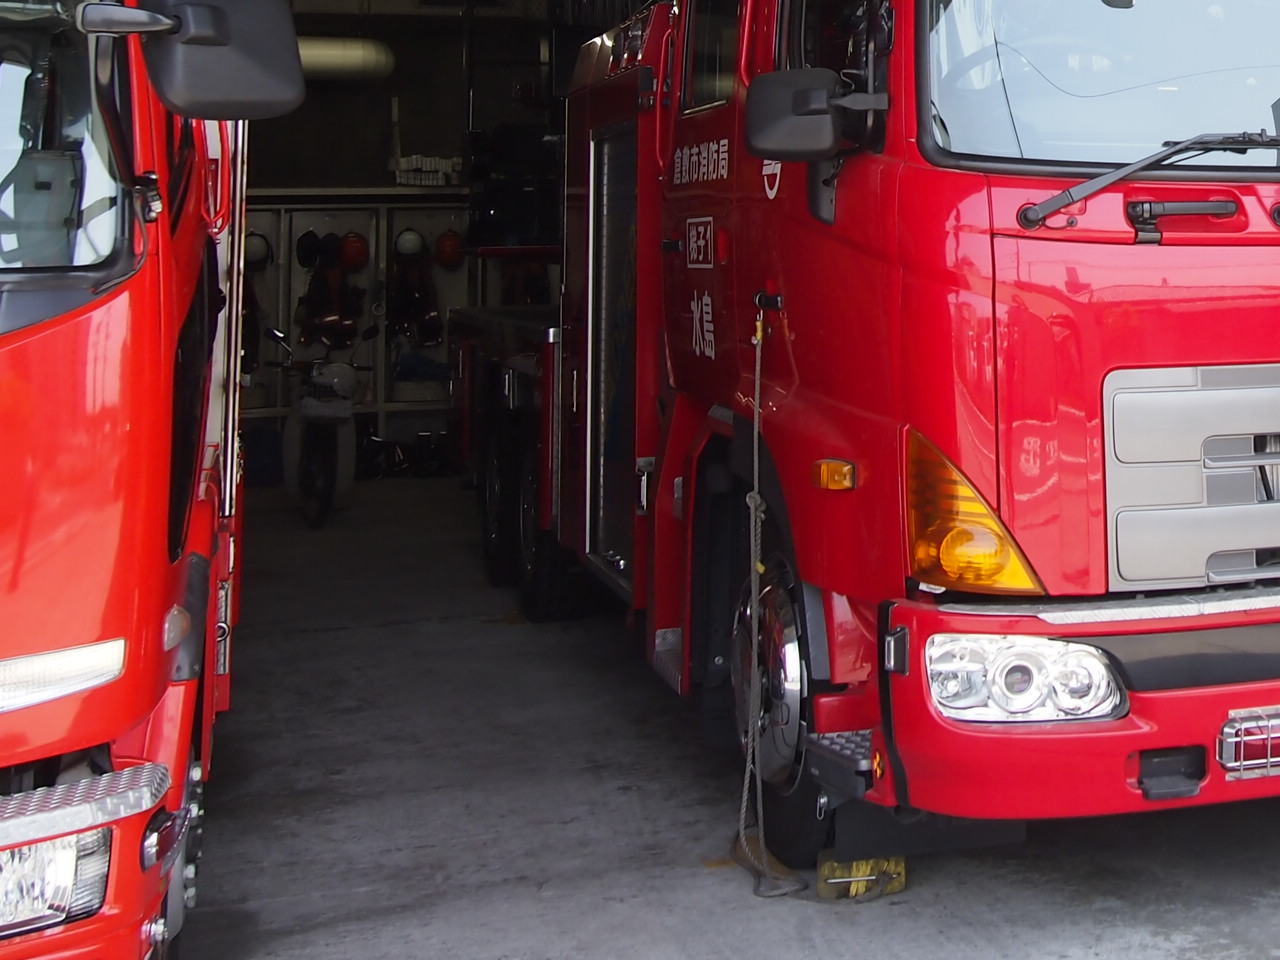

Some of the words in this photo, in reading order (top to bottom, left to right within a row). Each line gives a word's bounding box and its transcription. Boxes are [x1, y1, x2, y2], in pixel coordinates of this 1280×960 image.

[673, 138, 729, 185] 倉敷市消防局
[690, 288, 715, 361] 水島
